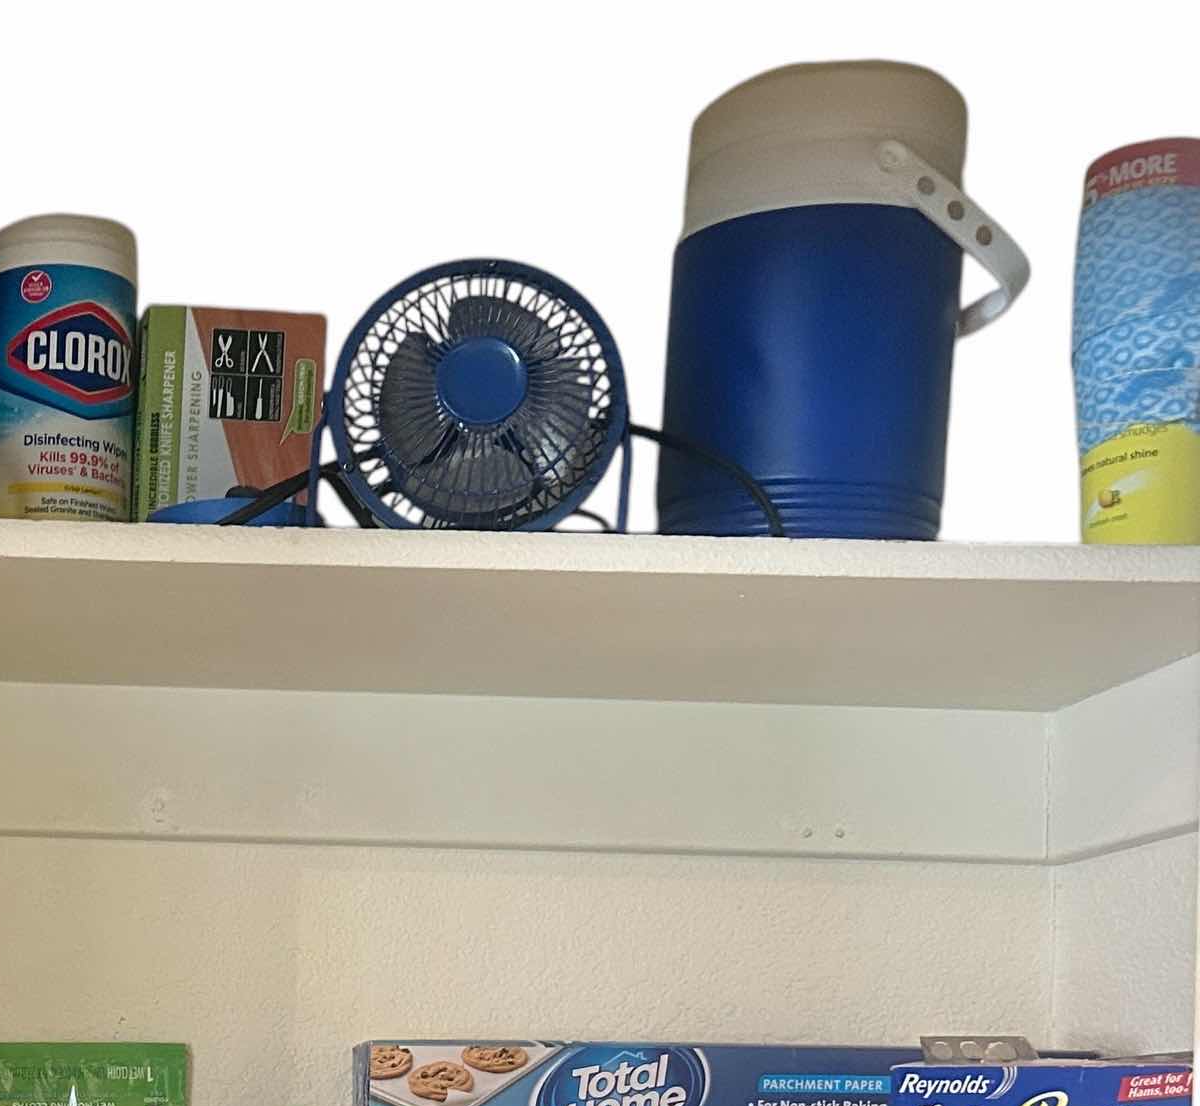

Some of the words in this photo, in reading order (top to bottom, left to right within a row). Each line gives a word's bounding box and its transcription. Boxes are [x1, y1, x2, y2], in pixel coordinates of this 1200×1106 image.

[1109, 153, 1177, 186] MORE
[26, 330, 131, 386] CLOROX
[163, 350, 176, 421] SHARPENER
[188, 370, 203, 460] SHARPENING
[24, 433, 100, 452] Disinfecting
[160, 423, 174, 456] KNIFE
[40, 451, 66, 463] Kills
[69, 452, 109, 468] 99.9%
[1130, 449, 1159, 461] shine
[80, 466, 88, 478] &
[572, 1054, 669, 1101] Total
[763, 1078, 841, 1092] PARCHMENT
[844, 1079, 883, 1092] PAPER
[899, 1073, 990, 1099] Reynolds
[1130, 1074, 1163, 1087] Great
[1164, 1073, 1184, 1084] for
